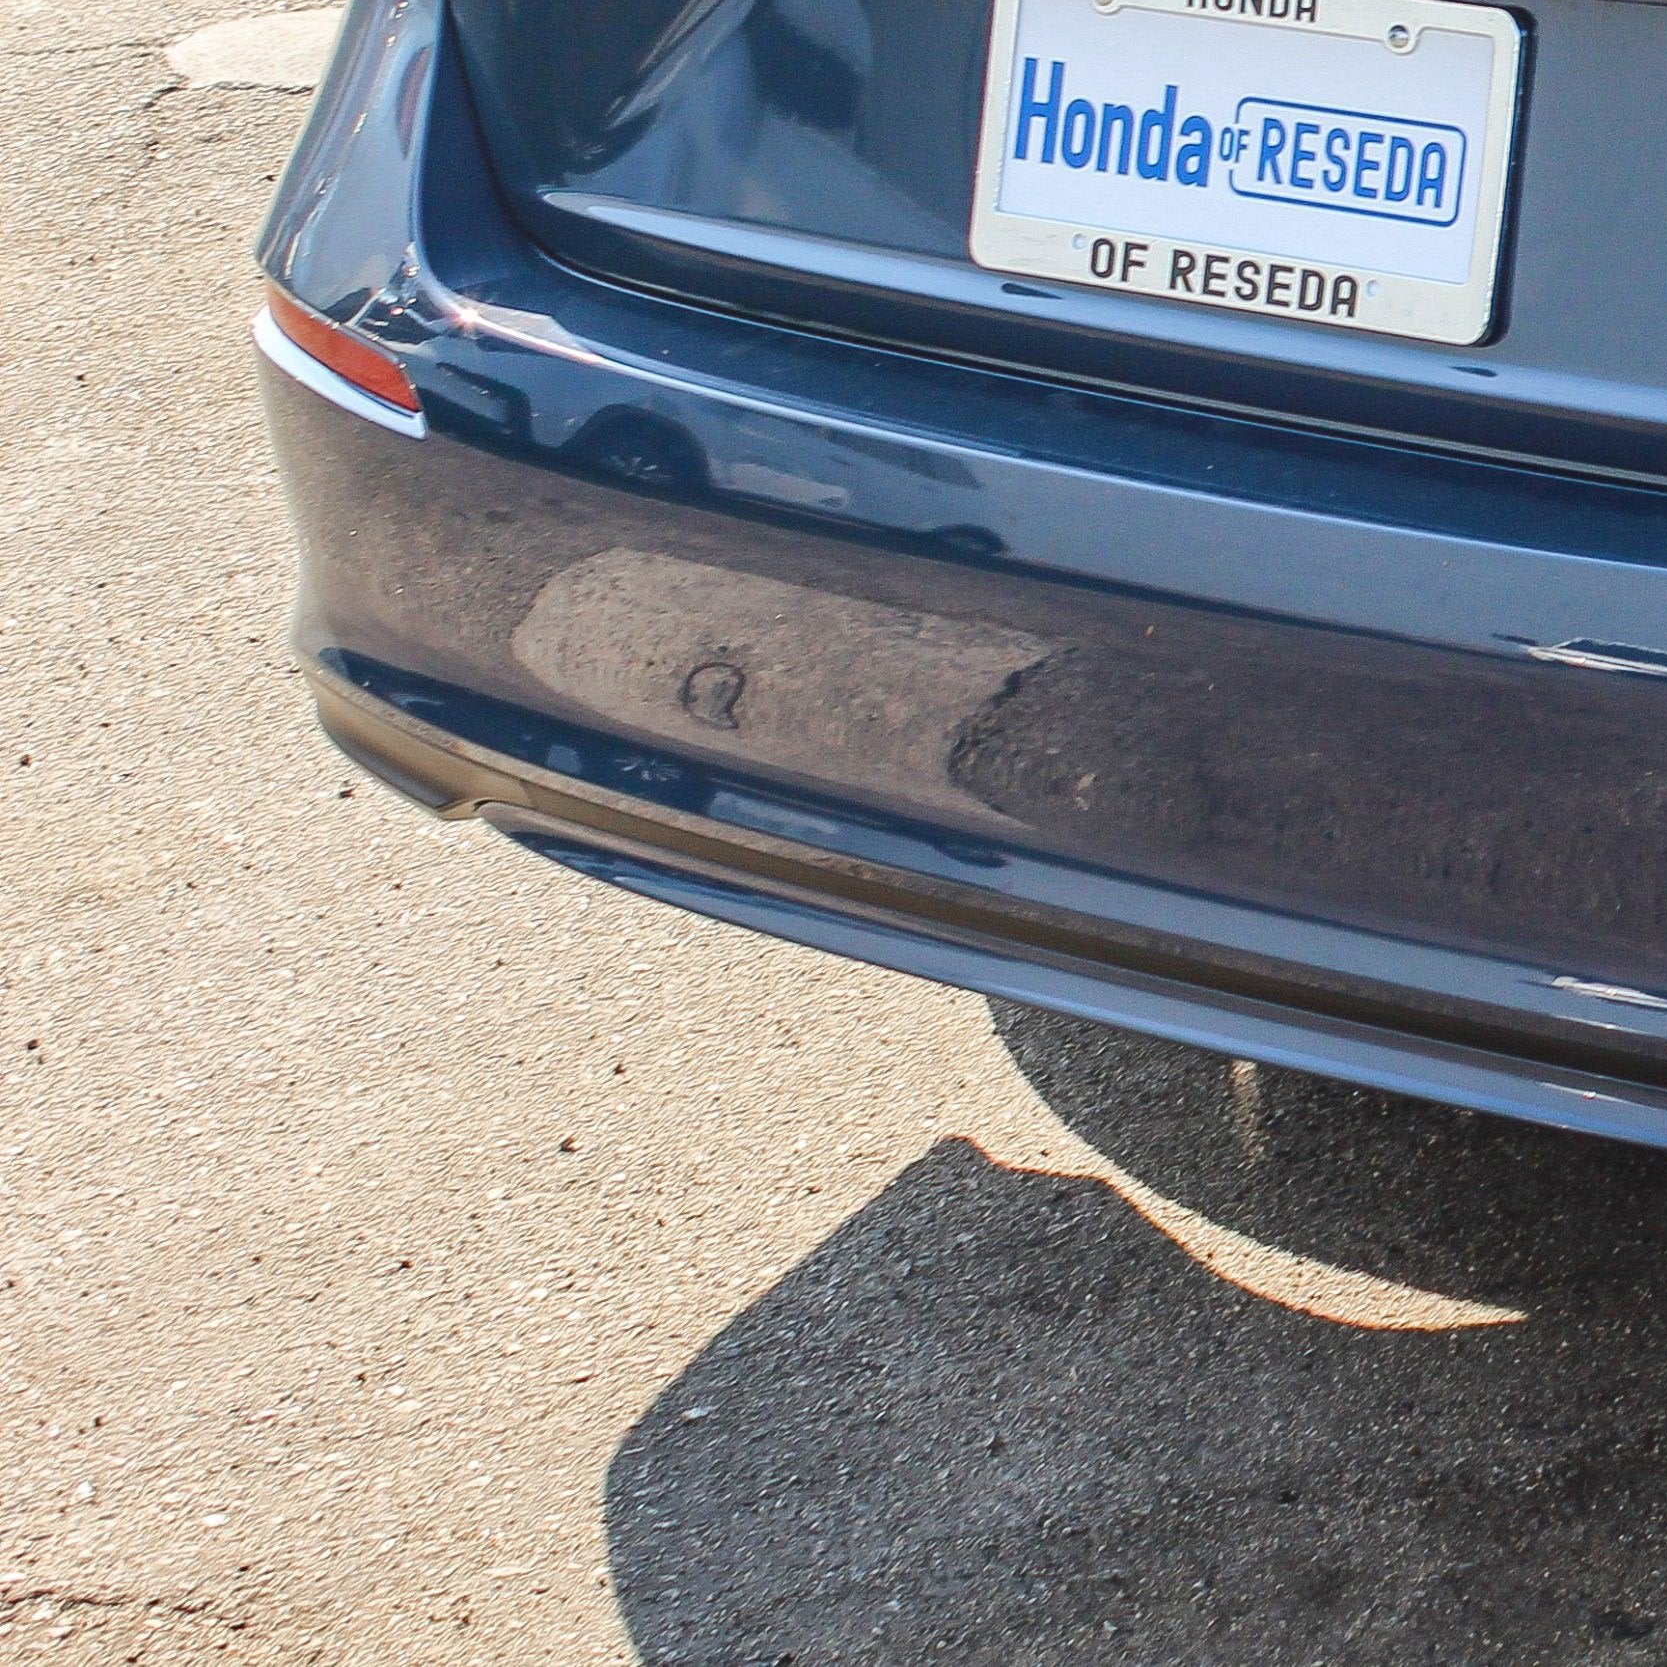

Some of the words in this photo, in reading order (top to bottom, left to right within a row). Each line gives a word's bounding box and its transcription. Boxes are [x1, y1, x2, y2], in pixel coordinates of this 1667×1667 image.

[1014, 57, 1213, 189] Honda
[1219, 125, 1252, 164] OF
[1256, 118, 1447, 209] RESEDA
[1089, 237, 1148, 283] OF
[1170, 249, 1361, 319] RESEDA
